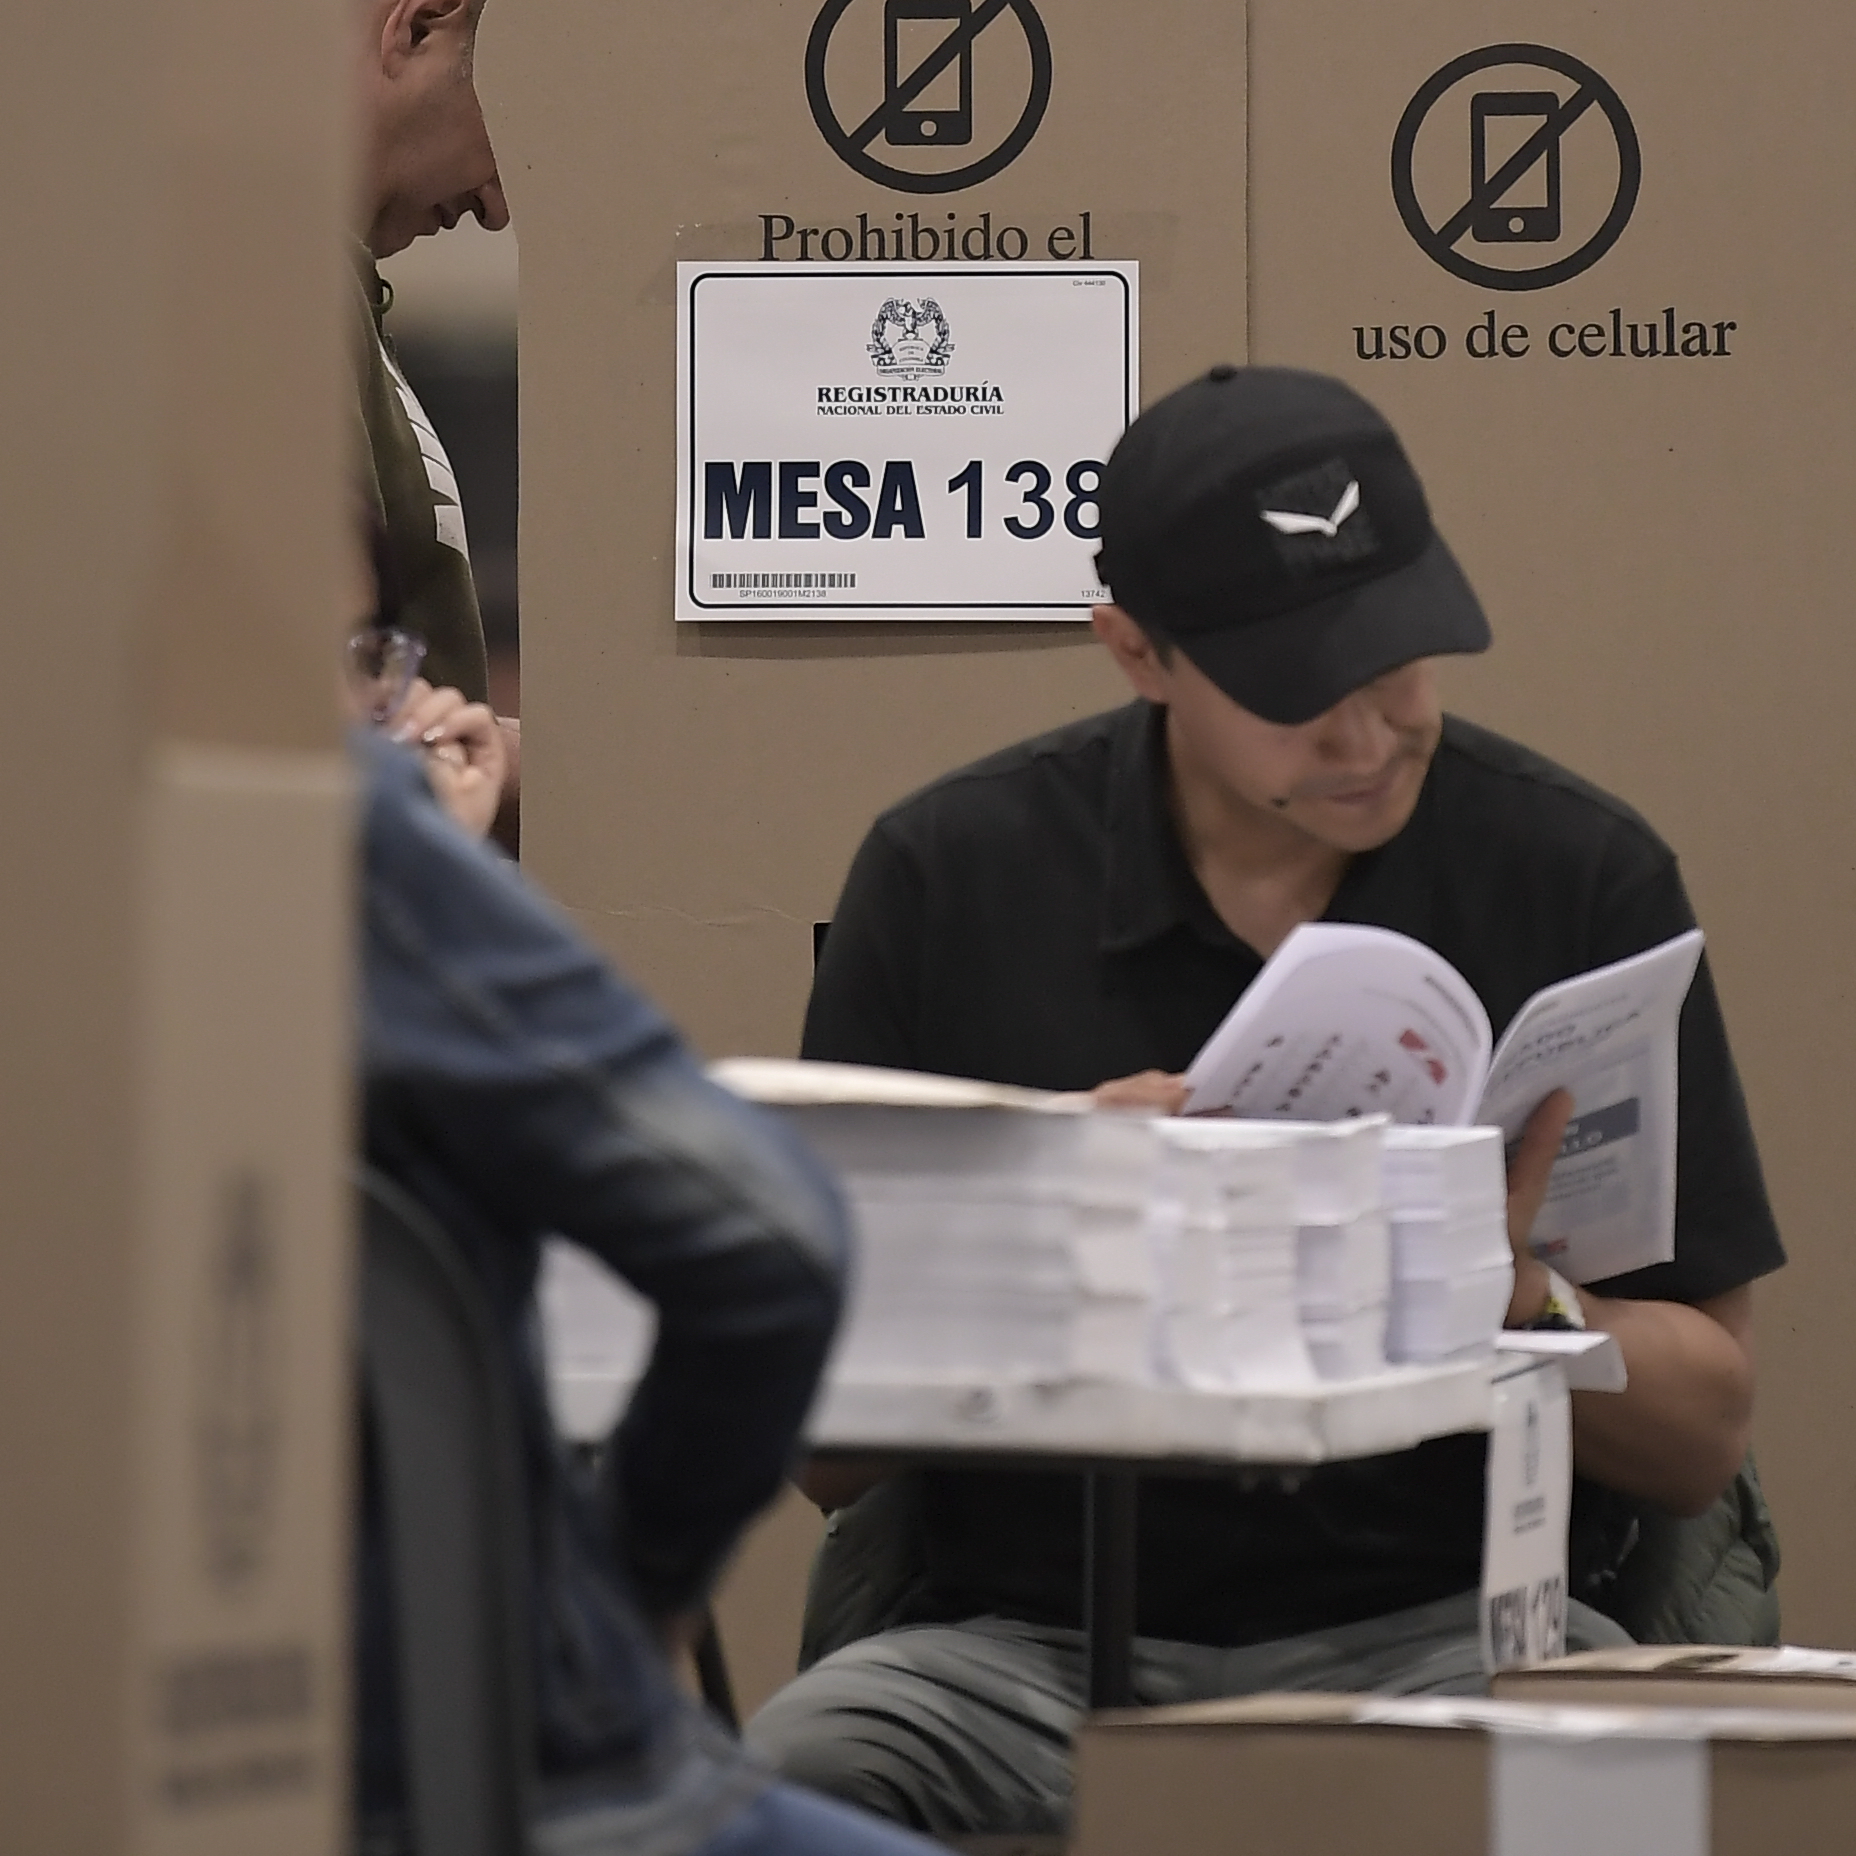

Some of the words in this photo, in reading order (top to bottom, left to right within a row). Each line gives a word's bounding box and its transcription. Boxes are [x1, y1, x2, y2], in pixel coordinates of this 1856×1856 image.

[757, 213, 1029, 262] Prohibido
[1047, 212, 1095, 261] el
[1352, 322, 1448, 361] uso
[1465, 309, 1531, 359] de
[1547, 307, 1738, 357] celular
[817, 380, 1005, 403] REGISTRADURÍA
[817, 405, 882, 415] NACIONAL
[886, 405, 912, 415] DEL
[916, 405, 967, 415] ESTADO
[970, 405, 1005, 415] CIVIL
[703, 460, 926, 540] MESA
[948, 459, 1107, 541] 138
